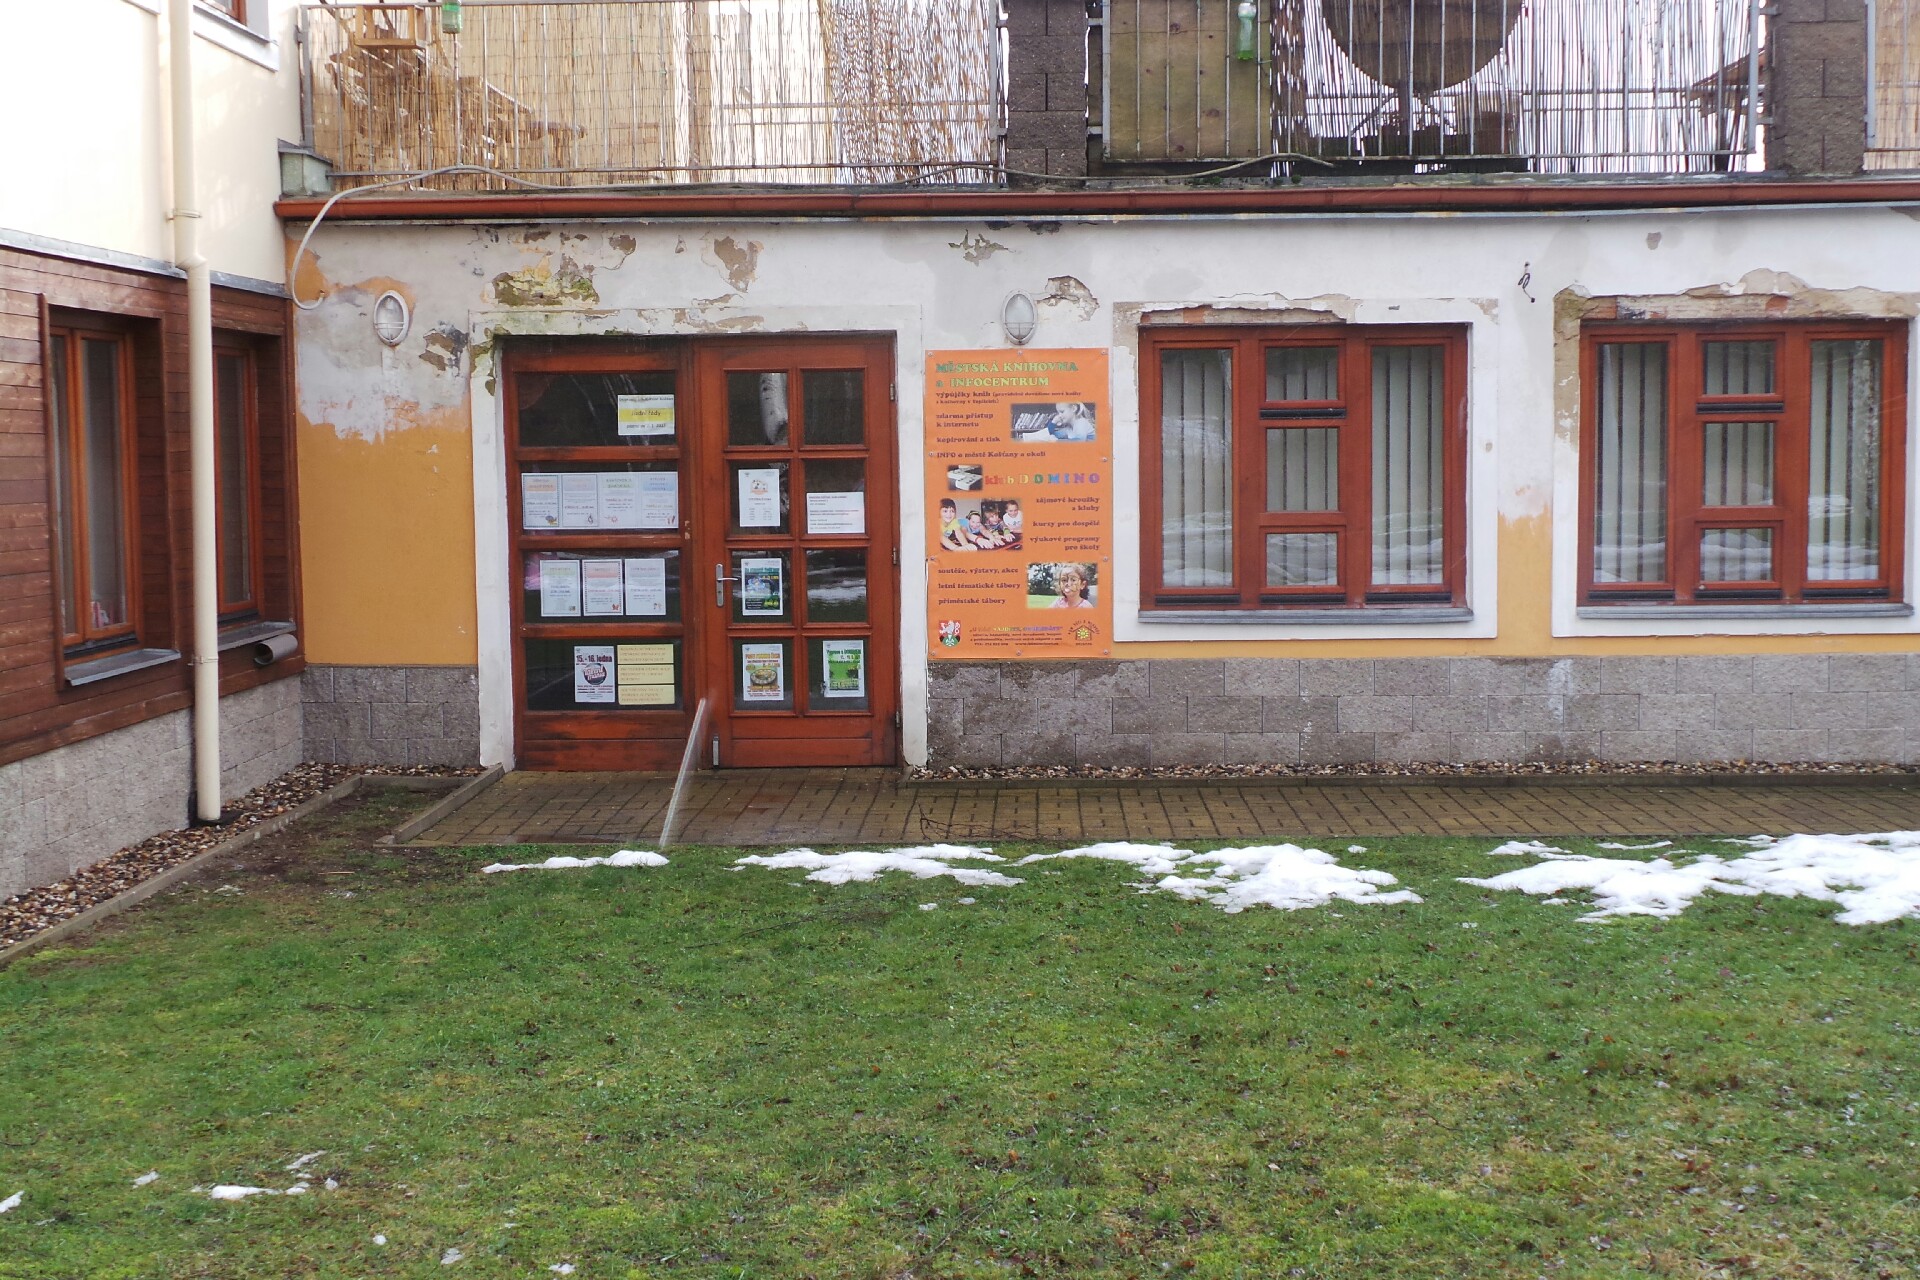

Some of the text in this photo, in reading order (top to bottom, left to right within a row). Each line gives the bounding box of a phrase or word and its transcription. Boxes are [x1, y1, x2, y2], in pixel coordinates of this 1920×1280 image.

[1003, 362, 1078, 372] KNIHOVNA
[951, 377, 1049, 387] INFOCENTRUM
[1019, 473, 1100, 484] DOMINO
